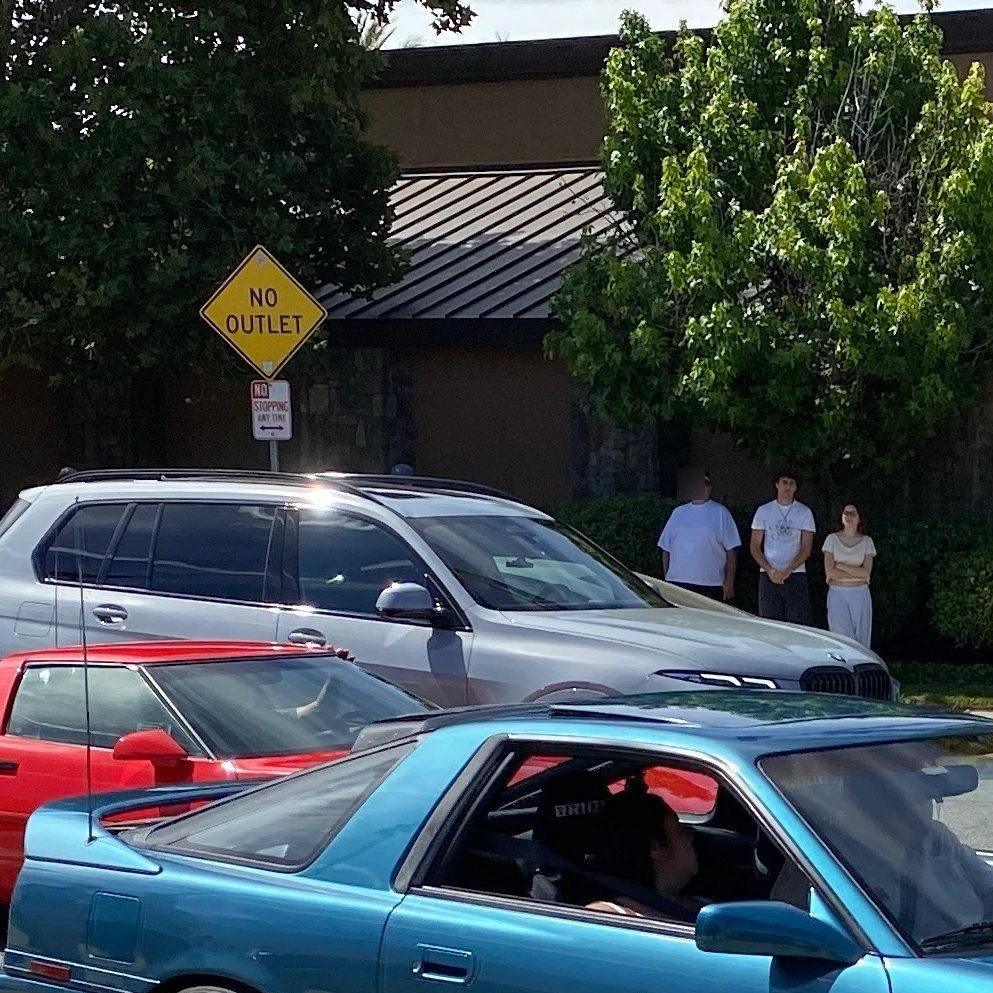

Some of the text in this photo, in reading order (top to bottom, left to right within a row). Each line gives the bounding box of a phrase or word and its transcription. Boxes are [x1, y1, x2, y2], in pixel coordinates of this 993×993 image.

[249, 287, 277, 307] NO
[225, 314, 303, 334] OUTLET
[254, 383, 268, 397] NO
[254, 401, 289, 412] STOPPING
[257, 413, 286, 422] ANY TIME
